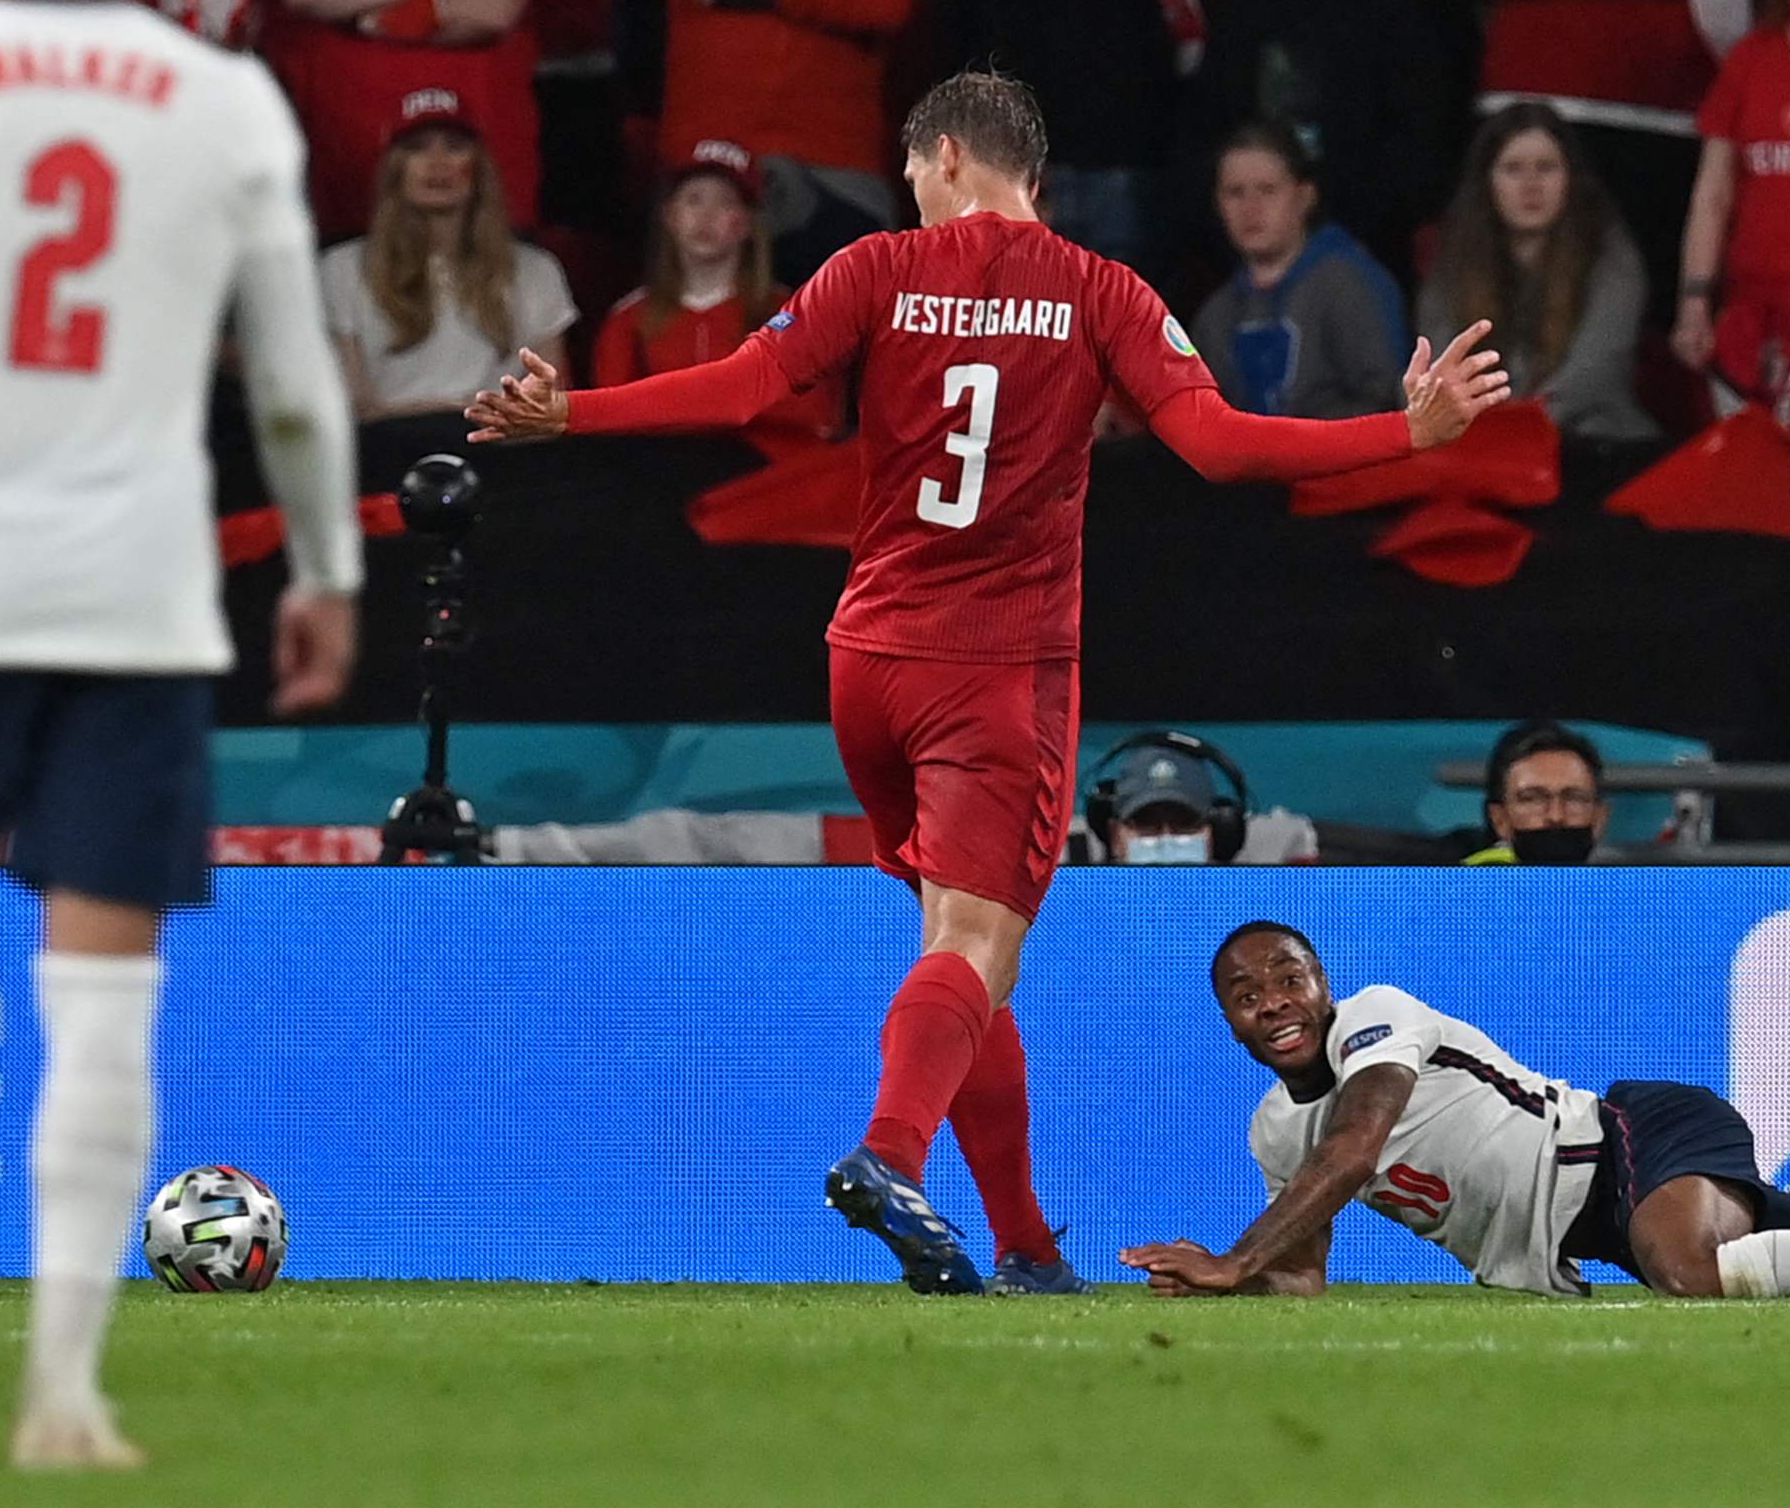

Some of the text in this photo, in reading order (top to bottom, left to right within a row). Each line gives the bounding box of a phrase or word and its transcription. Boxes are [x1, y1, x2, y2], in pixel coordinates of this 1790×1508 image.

[9, 139, 120, 374] 2
[891, 291, 1072, 341] VESTERGAARD
[916, 363, 999, 529] 3
